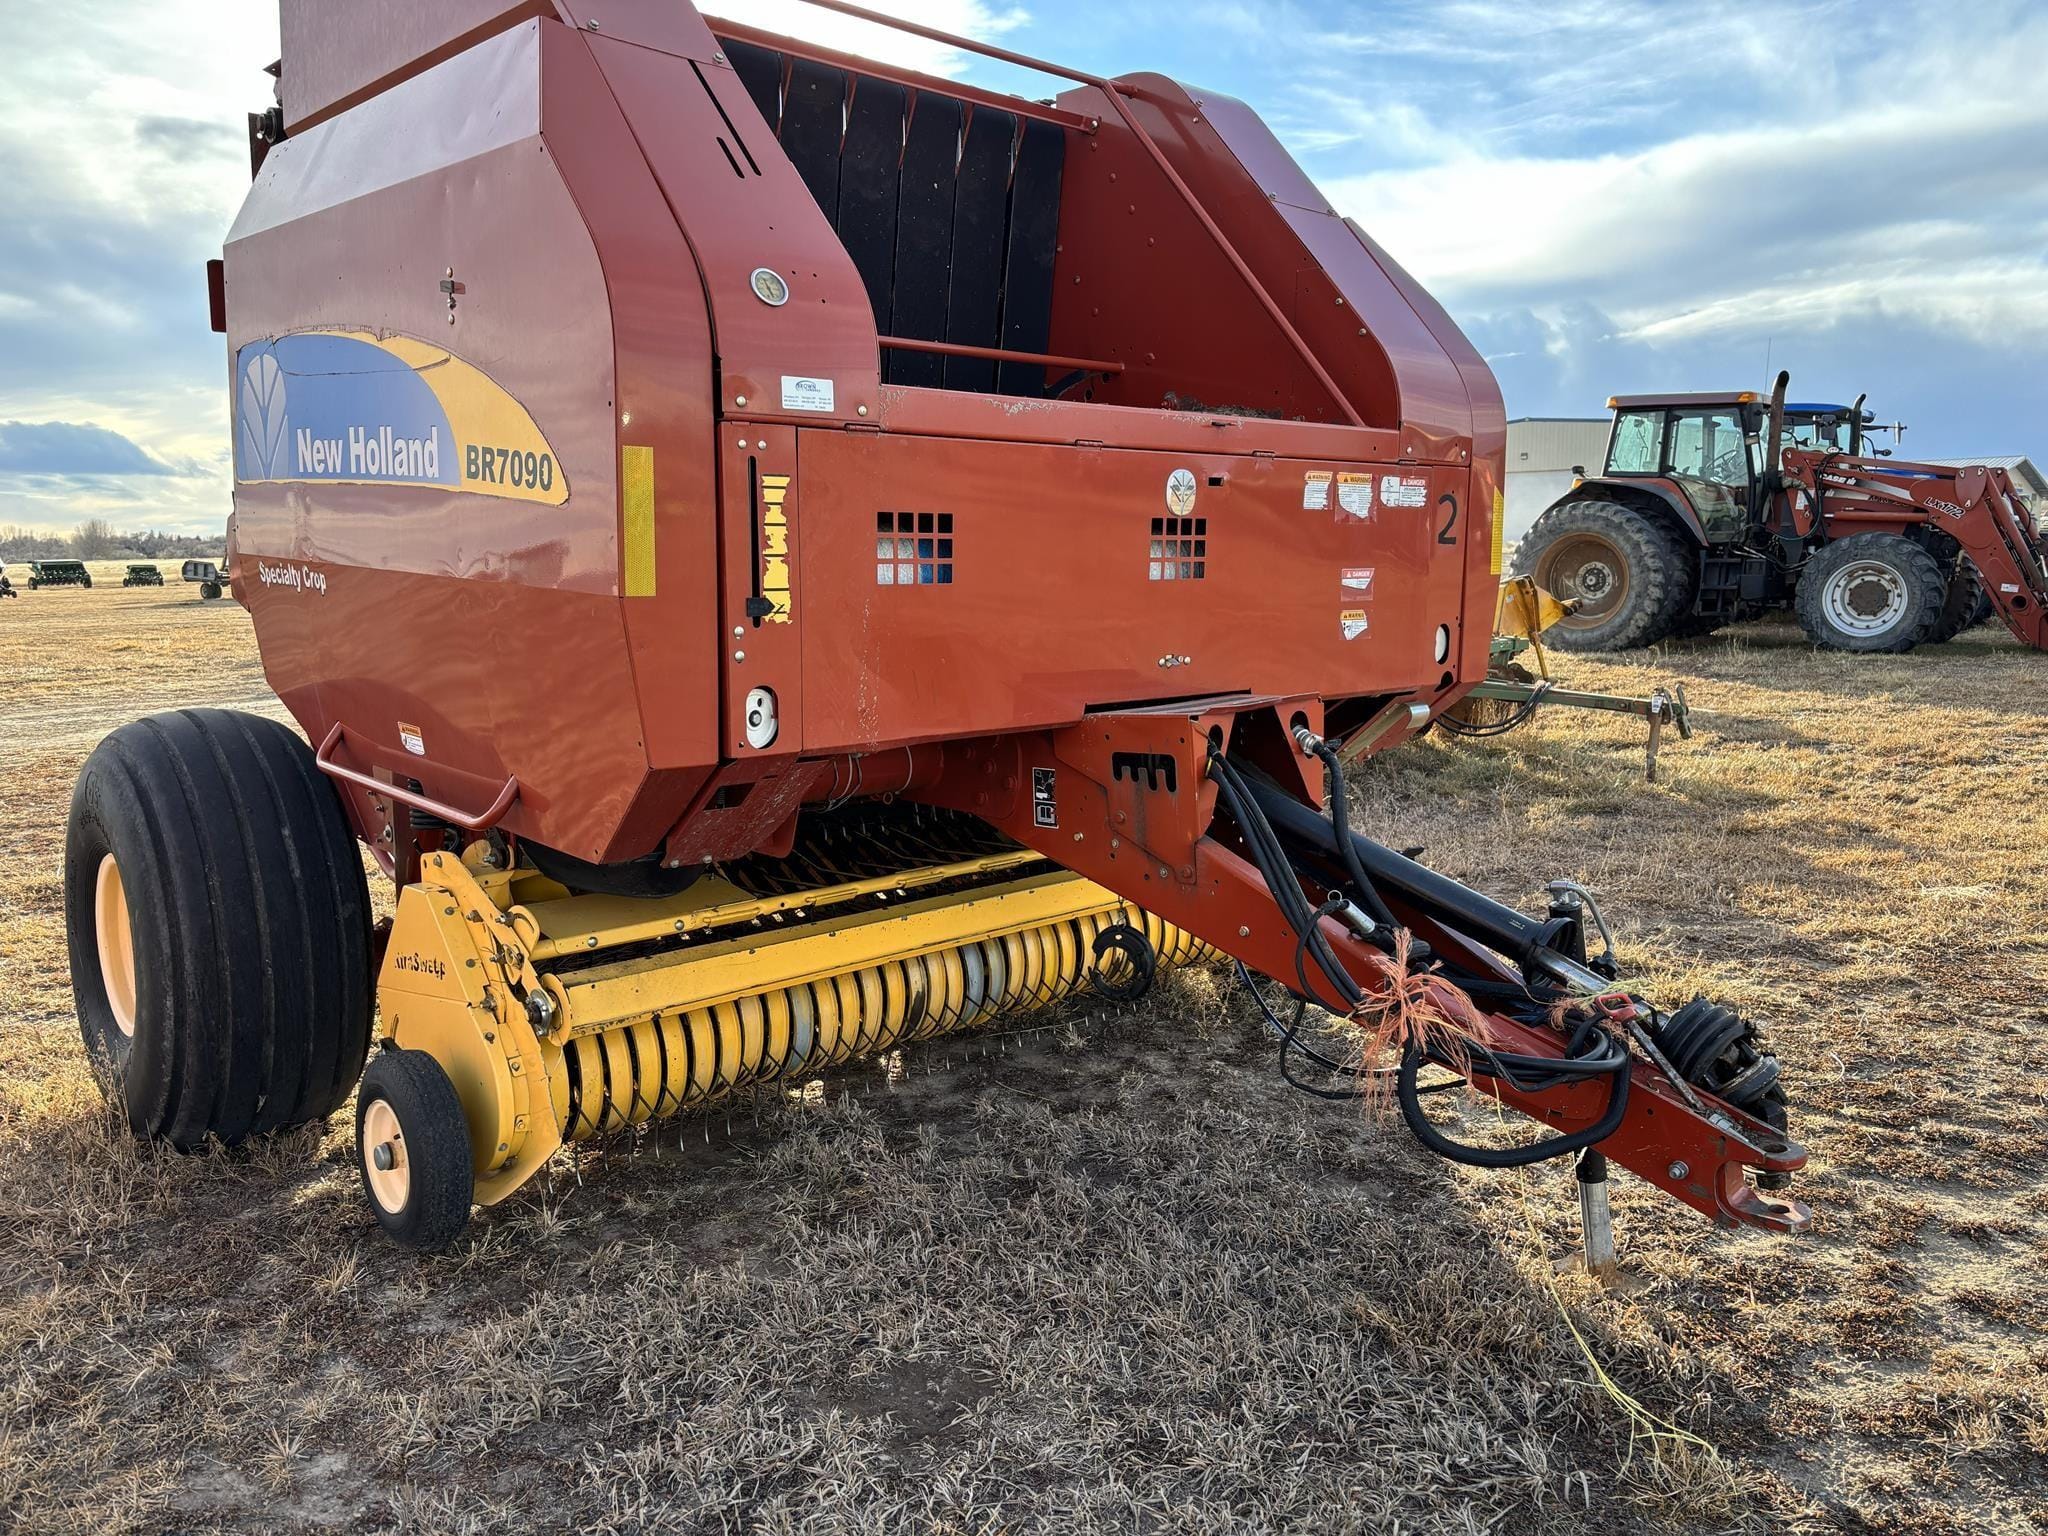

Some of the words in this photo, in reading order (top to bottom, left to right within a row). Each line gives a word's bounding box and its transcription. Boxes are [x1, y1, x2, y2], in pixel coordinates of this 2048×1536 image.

[297, 428, 343, 474] New
[349, 425, 439, 478] Holland
[465, 444, 553, 492] BR7090
[1438, 494, 1458, 545] 2
[1925, 497, 1965, 519] LX172
[259, 560, 302, 592] Specialty
[302, 565, 327, 597] Crop
